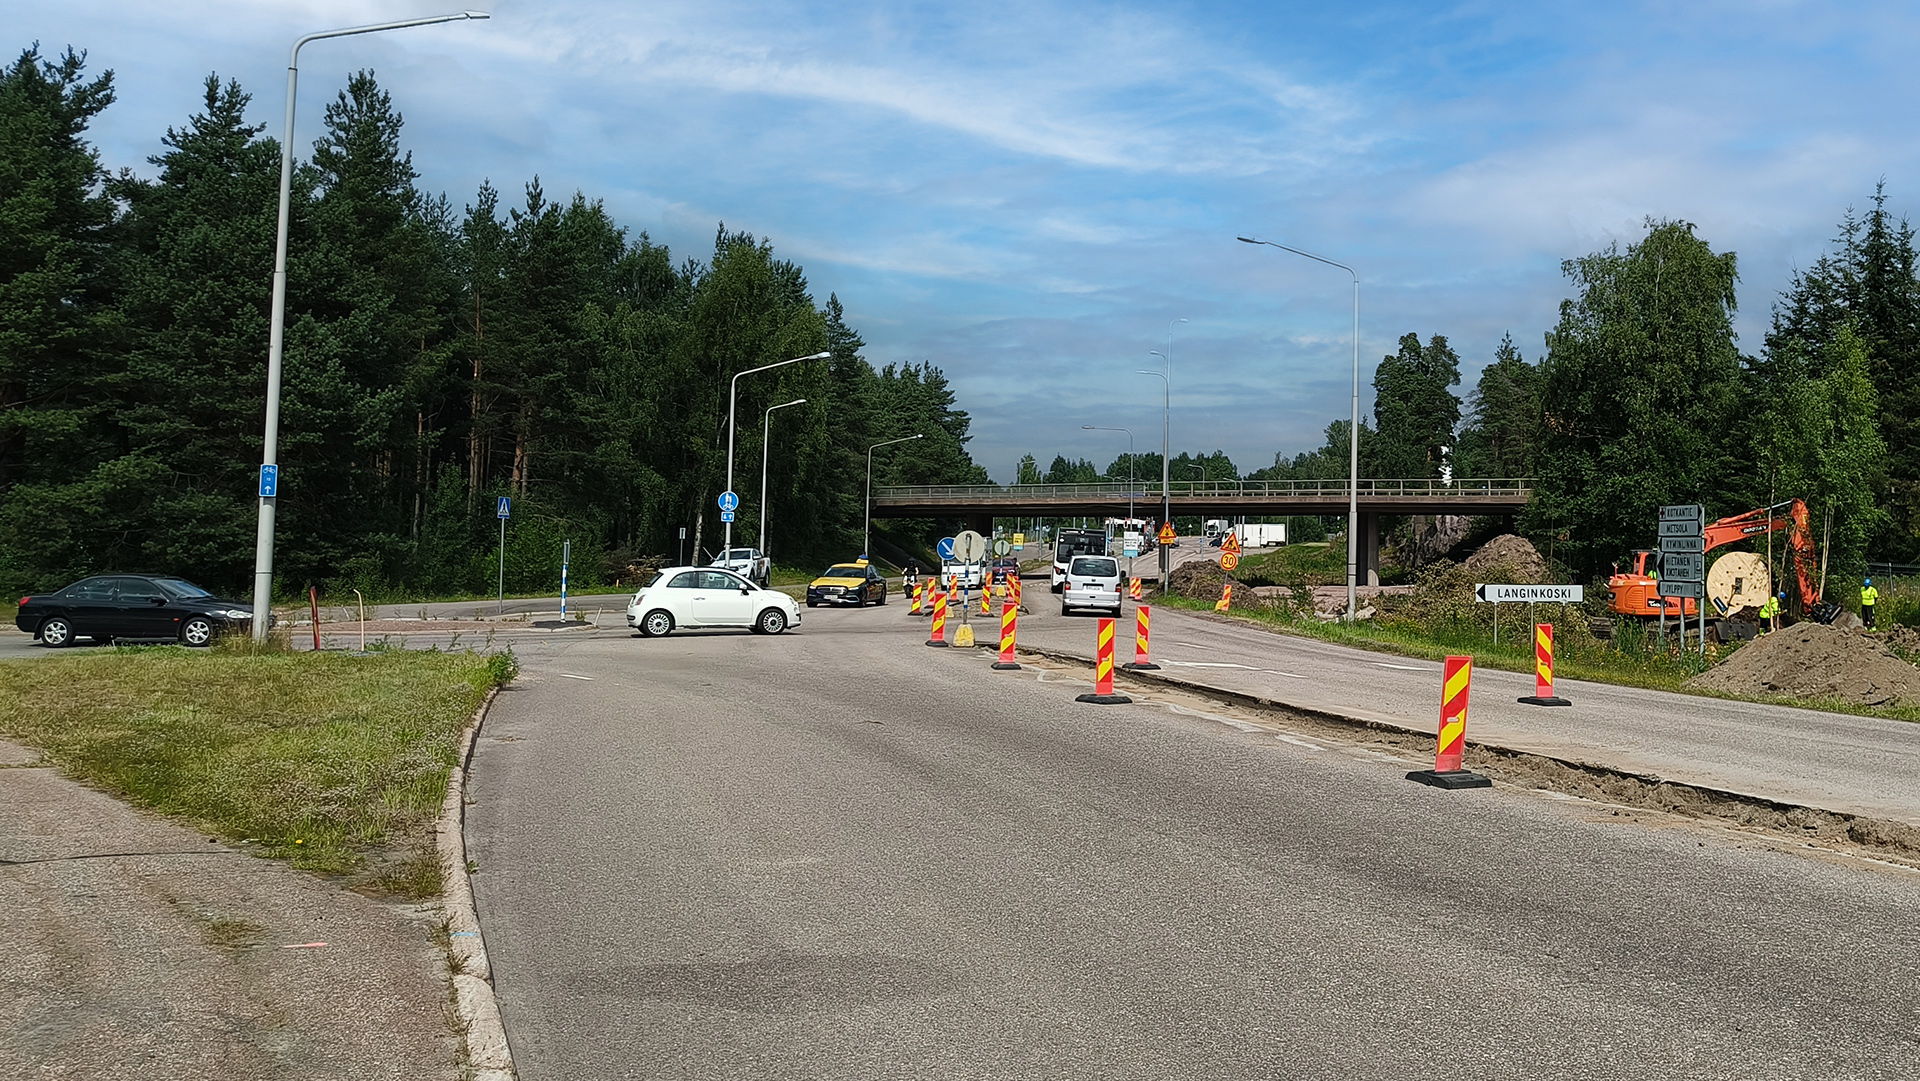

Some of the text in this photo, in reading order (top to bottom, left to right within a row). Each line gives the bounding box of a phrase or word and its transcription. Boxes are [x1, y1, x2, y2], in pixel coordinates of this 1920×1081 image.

[1666, 523, 1688, 533] METSOLA
[1223, 555, 1234, 566] 30
[1497, 588, 1571, 599] LANGINKOSKI
